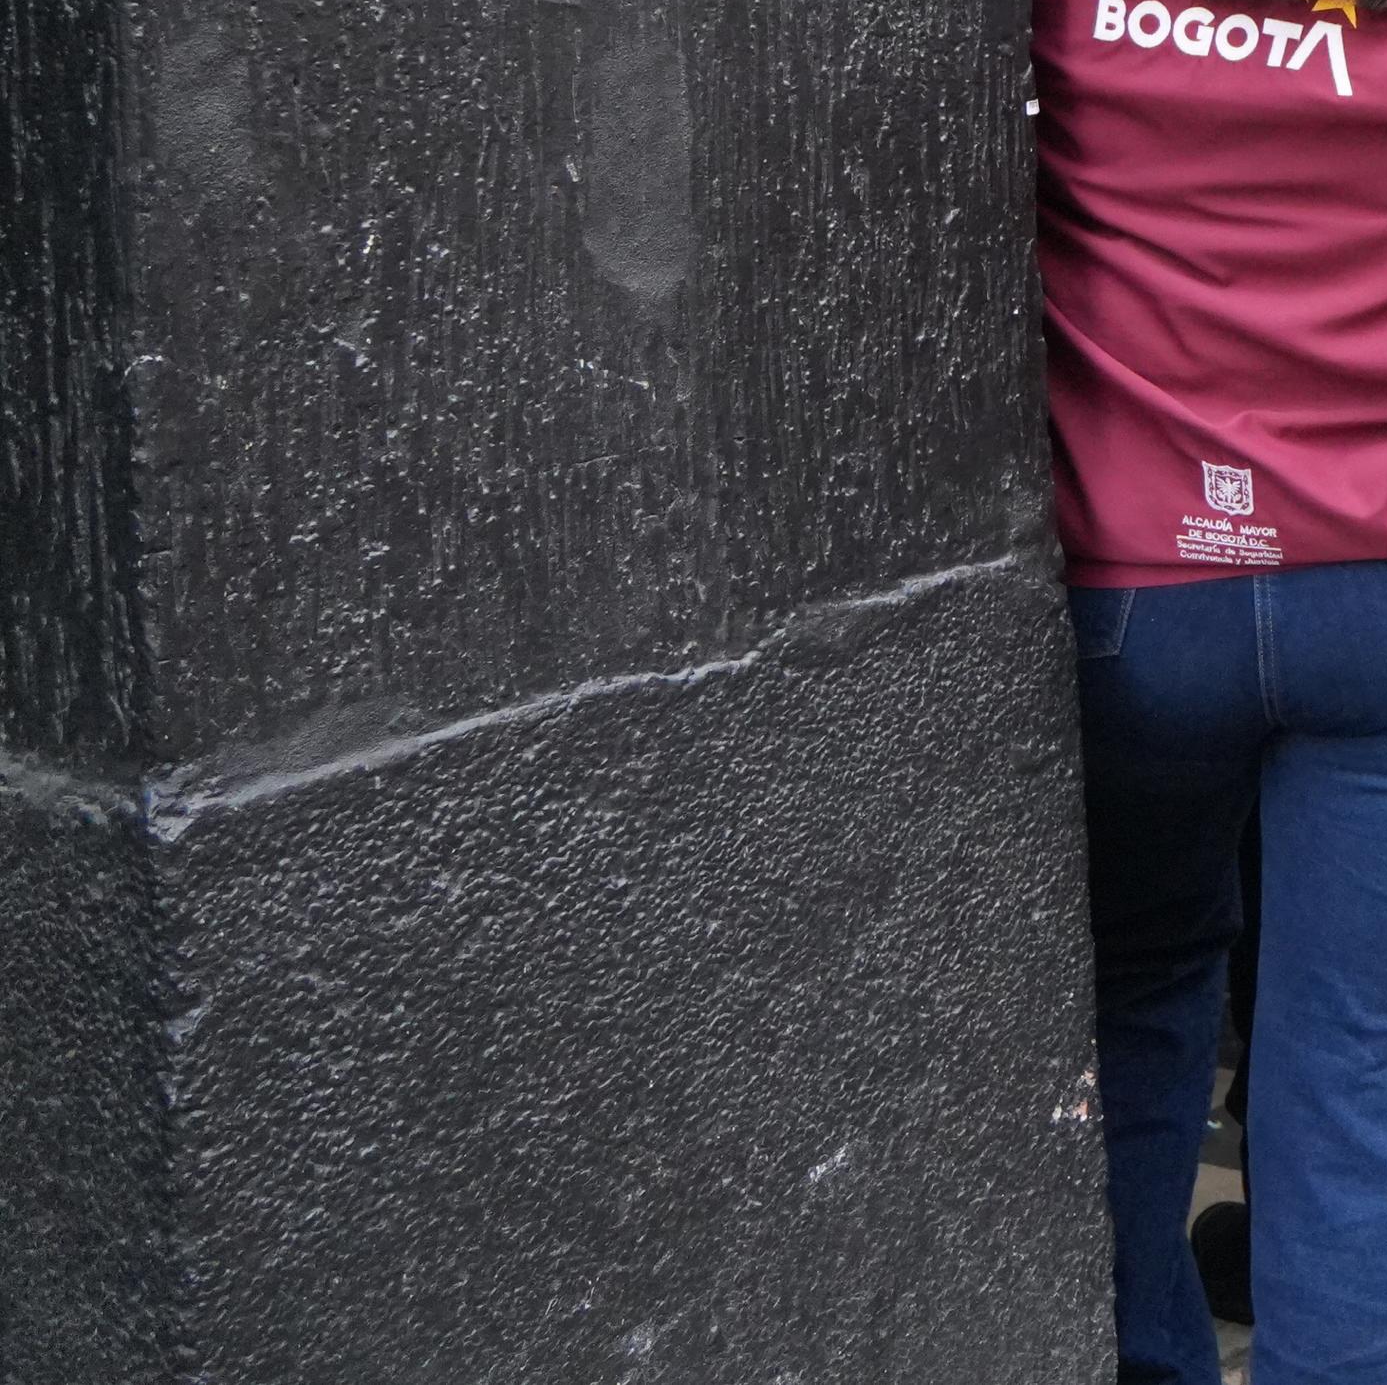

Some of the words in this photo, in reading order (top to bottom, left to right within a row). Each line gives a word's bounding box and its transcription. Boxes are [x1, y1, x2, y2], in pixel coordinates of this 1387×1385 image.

[1182, 515, 1233, 532] ALCALDÍA
[1240, 525, 1277, 537] MAYOR
[1188, 528, 1203, 538] DE
